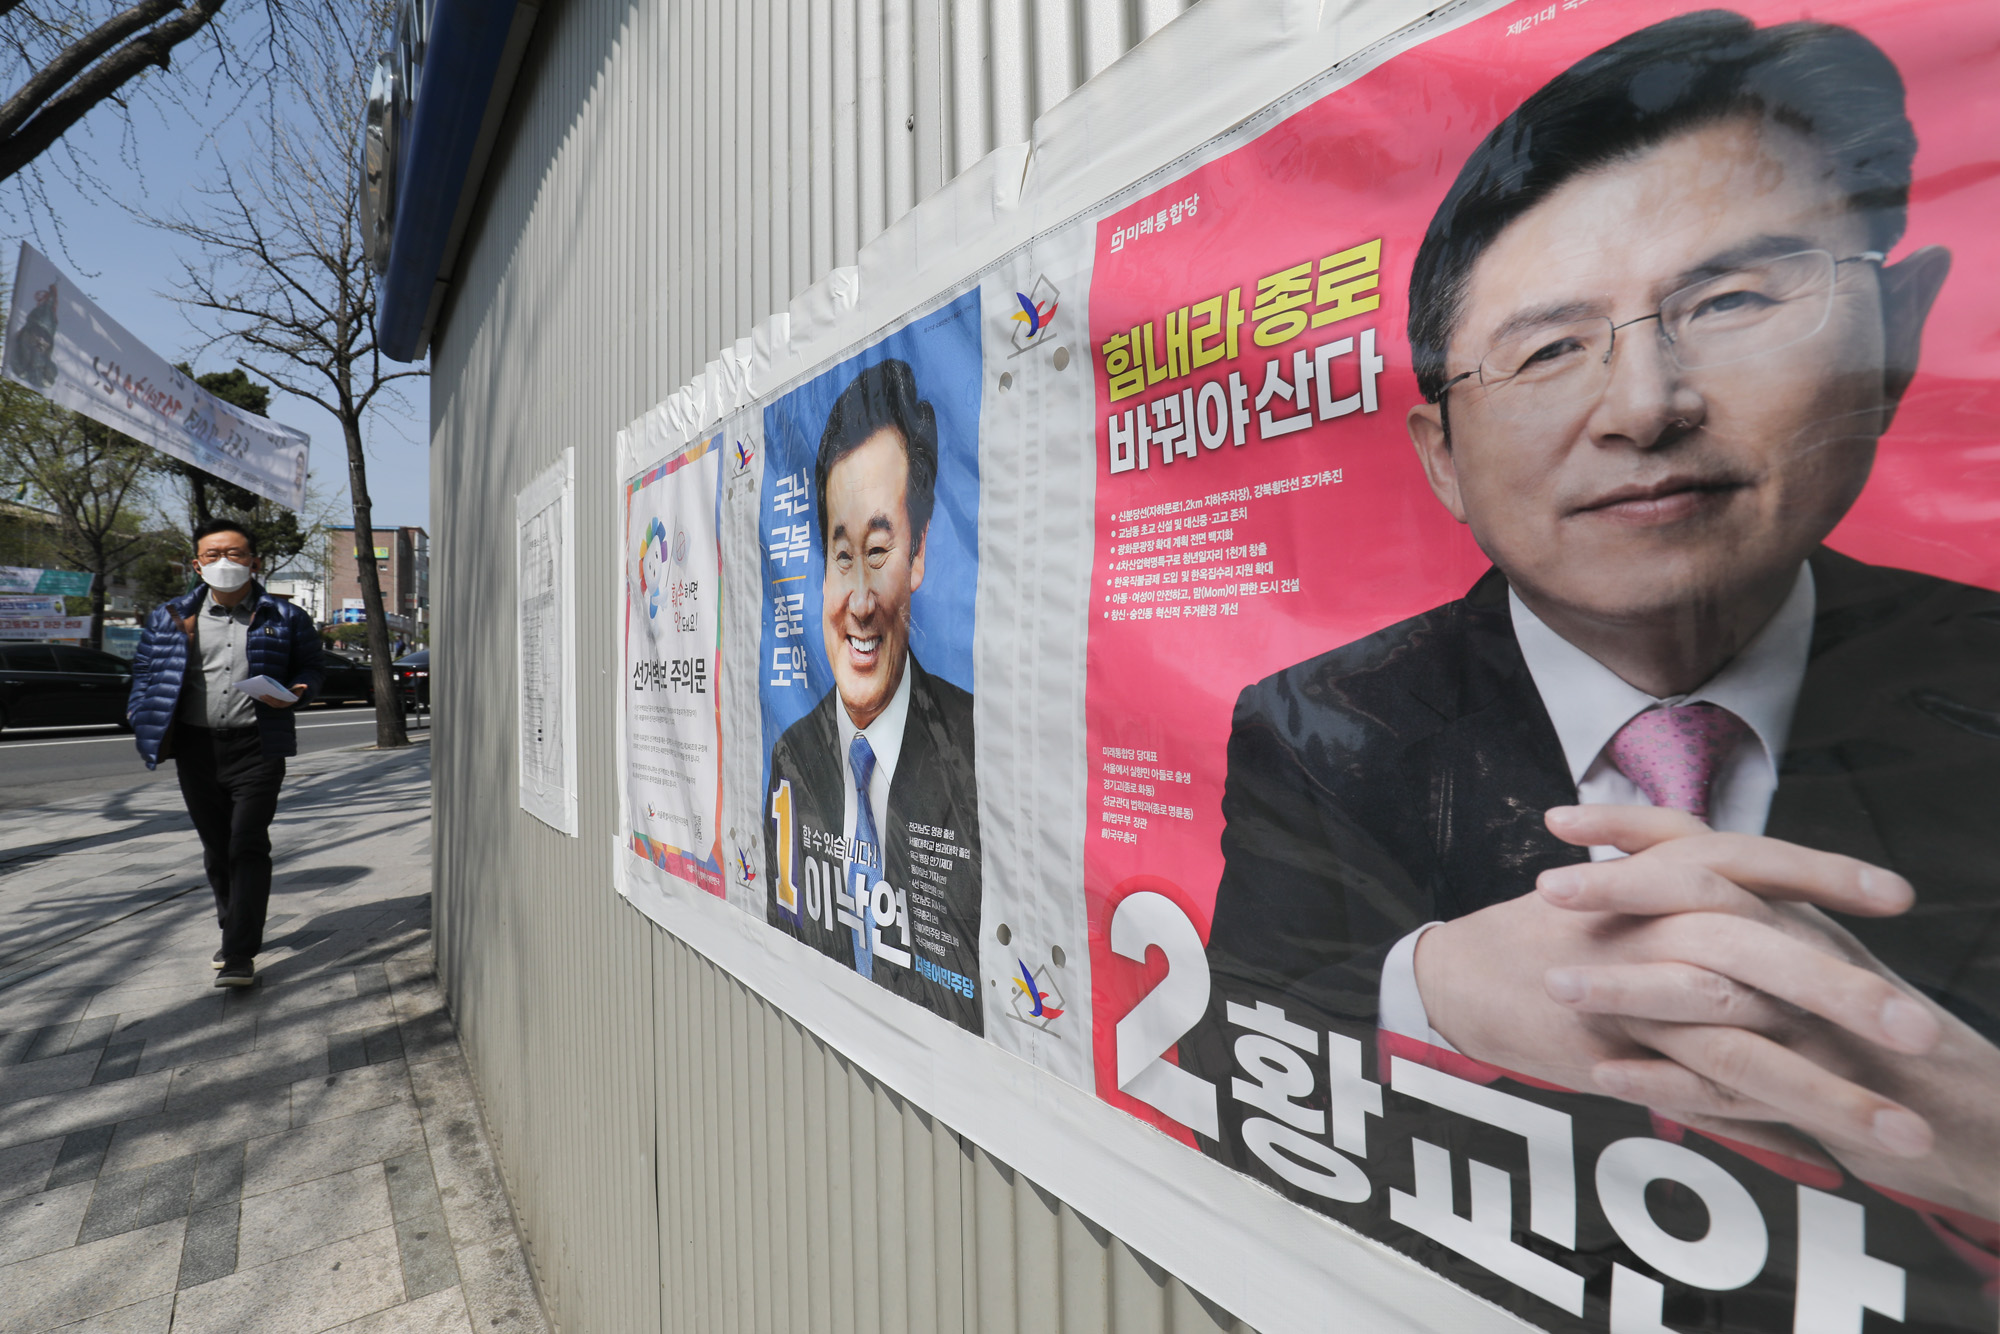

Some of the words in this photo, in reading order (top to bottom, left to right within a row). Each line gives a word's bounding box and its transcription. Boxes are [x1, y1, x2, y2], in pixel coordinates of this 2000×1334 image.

[1506, 5, 1556, 37] 제21대
[1126, 193, 1199, 241] 미래통합당
[1102, 287, 1245, 402] 힘내라
[1252, 238, 1381, 347] 종로
[1109, 371, 1250, 474] 바꿔야
[1255, 328, 1383, 440] 산다
[774, 467, 810, 517] 국난
[1254, 477, 1299, 499] 강북횡단선
[1301, 468, 1342, 488] 조기추진
[1118, 525, 1139, 538] 교남동
[1141, 523, 1155, 535] 초교
[1157, 521, 1173, 533] 신설
[1174, 518, 1182, 530] 및
[1230, 507, 1248, 521] 존치
[769, 520, 811, 567] 극복
[1116, 553, 1181, 572] 4차산업혁명특구로
[1183, 548, 1223, 565] 청년일자리
[1225, 545, 1247, 559] 1천개
[1249, 542, 1267, 557] 창출
[1117, 540, 1154, 556] 광화문광장
[1156, 537, 1171, 550] 확대
[1173, 535, 1188, 547] 계획
[1190, 532, 1206, 546] 전면
[1208, 528, 1233, 543] 백지화
[1162, 571, 1178, 584] 도입
[1181, 570, 1190, 582] 및
[1191, 566, 1234, 581] 한옥집수리
[1235, 563, 1253, 577] 지원
[1255, 561, 1273, 575] 확대
[1156, 588, 1191, 602] 안전하고,
[1239, 582, 1258, 596] 편한
[1259, 580, 1278, 594] 도시
[1280, 578, 1300, 593] 건설
[774, 593, 804, 639] 종로
[1155, 606, 1180, 619] 혁신적
[1183, 604, 1217, 618] 주거환경
[1220, 602, 1238, 616] 개선
[633, 659, 667, 692] 선거벽보
[670, 657, 707, 693] 주의문
[771, 646, 808, 689] 도약
[1102, 746, 1135, 760] 미래통합당
[1136, 750, 1158, 762] 당대표
[1102, 763, 1129, 776] 서울에서
[1130, 766, 1150, 779] 실향민
[1151, 769, 1174, 781] 아들로
[1175, 771, 1191, 784] 출생
[1102, 795, 1129, 809] 성균관대
[943, 828, 955, 840] 출생
[1133, 816, 1148, 830] 장관
[771, 779, 798, 915] 1
[802, 824, 811, 848] 할
[812, 832, 823, 852] 수
[823, 833, 878, 869] 있습니다!
[804, 855, 911, 969] 이낙연
[915, 954, 975, 999] 더불어민주당
[1110, 890, 1220, 1142] 2
[1225, 999, 1907, 1334] 황교안
